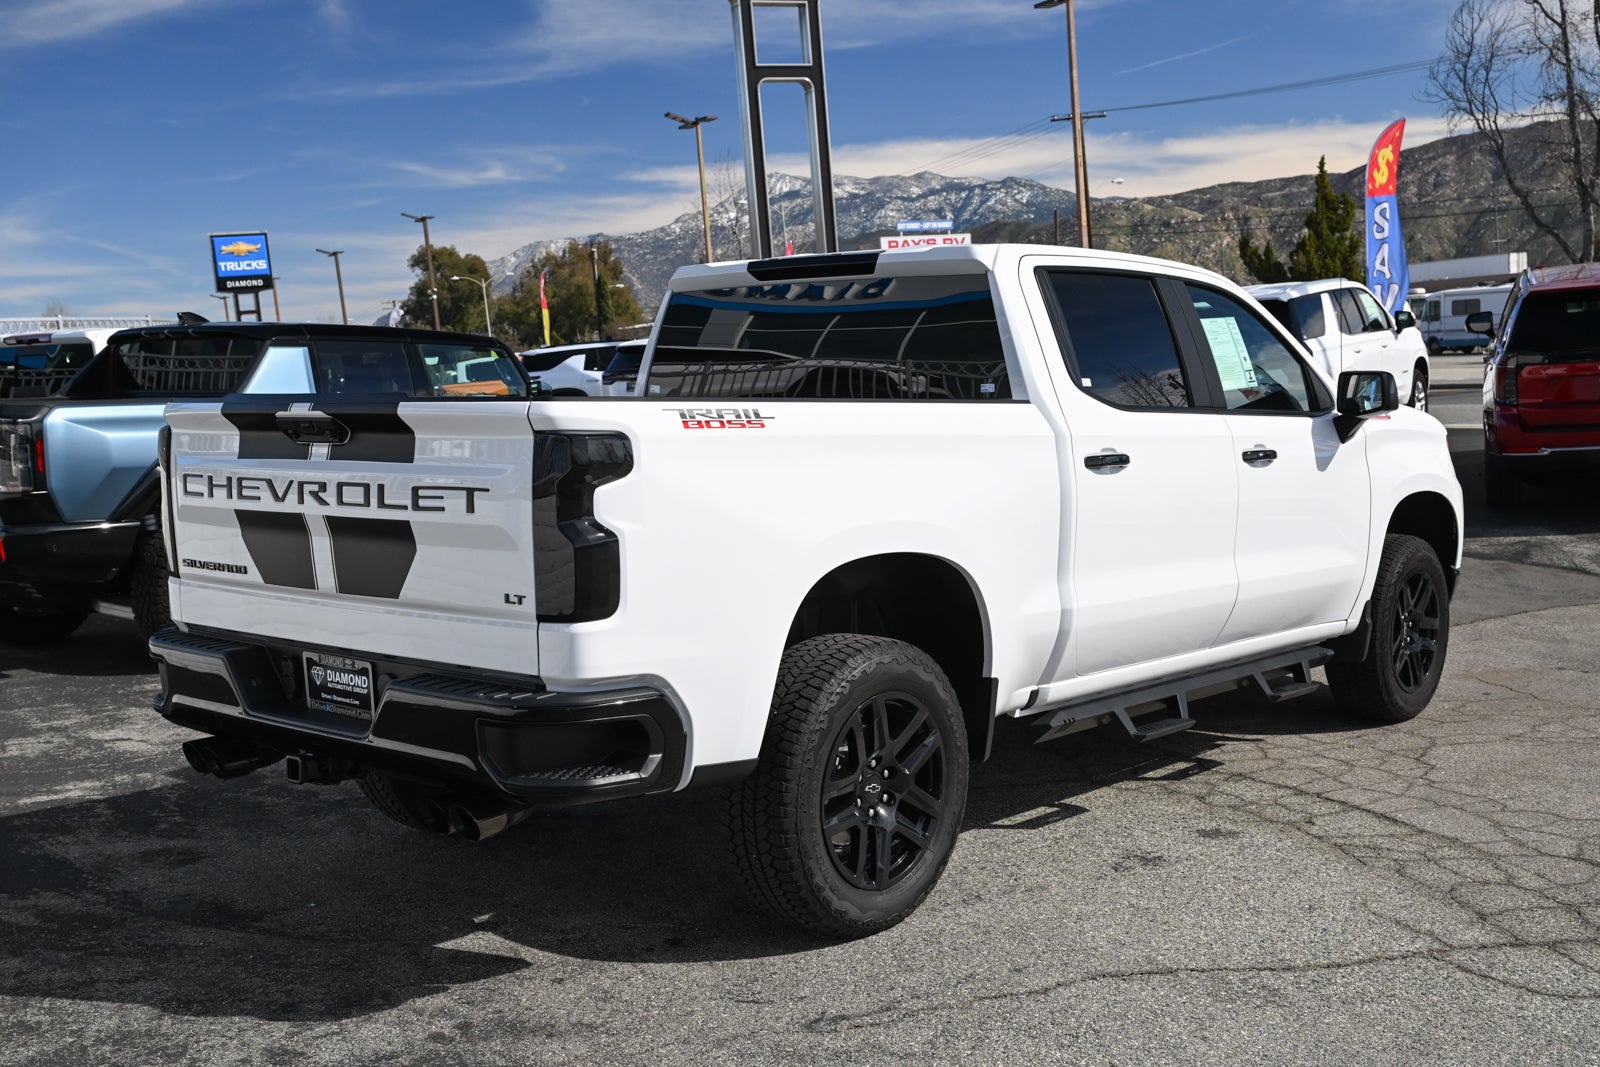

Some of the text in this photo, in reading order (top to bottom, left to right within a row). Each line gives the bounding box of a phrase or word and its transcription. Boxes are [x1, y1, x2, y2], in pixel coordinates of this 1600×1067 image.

[218, 259, 267, 271] TRUCKS
[226, 279, 263, 288] DIAMOND
[662, 408, 775, 420] TRAIL
[682, 420, 765, 429] BOSS
[183, 473, 490, 514] CHEVROLET
[182, 558, 248, 574] SILVERADO
[504, 593, 526, 605] LT
[326, 670, 368, 688] DIAMOND
[327, 682, 368, 694] AUTOMOTIVE GROUP
